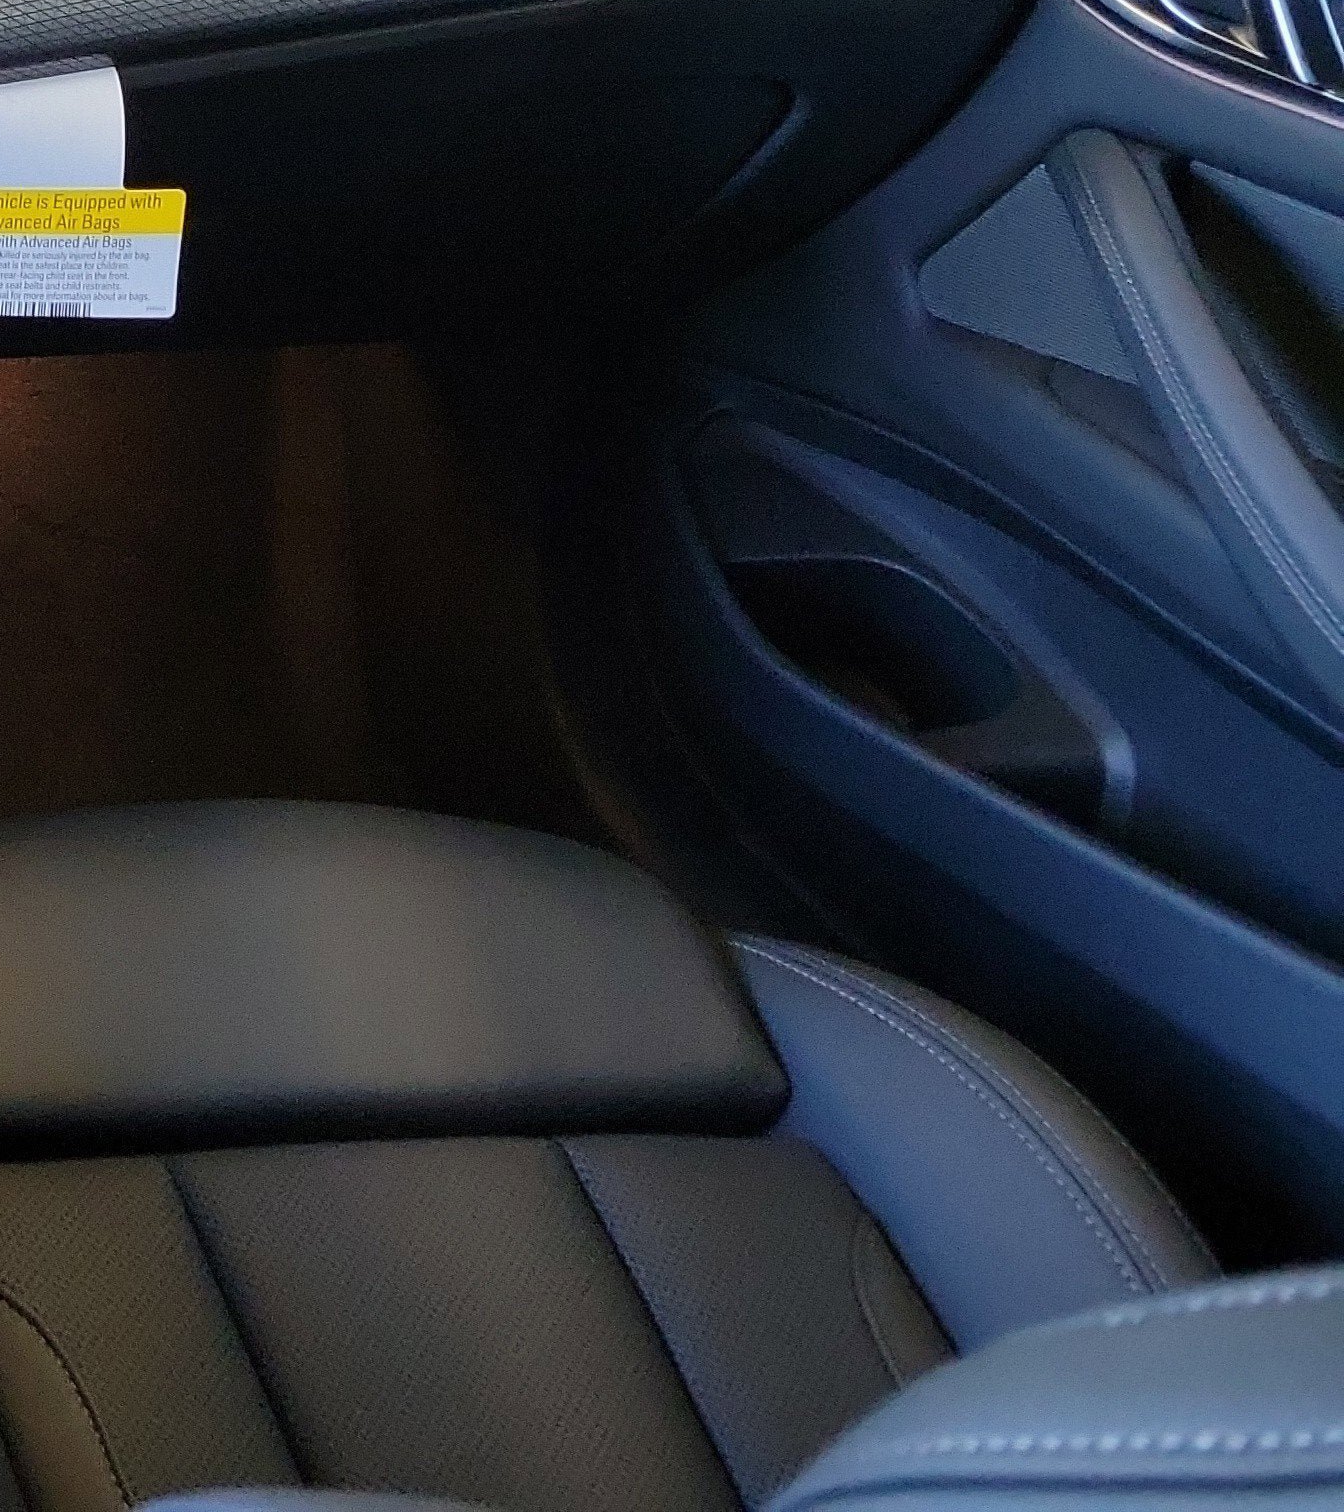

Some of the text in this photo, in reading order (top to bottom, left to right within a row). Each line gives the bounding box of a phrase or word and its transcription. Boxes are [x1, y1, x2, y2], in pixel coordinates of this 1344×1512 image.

[36, 193, 49, 209] is
[53, 193, 127, 212] Equipped
[130, 192, 162, 209] with
[56, 213, 78, 229] Air
[81, 213, 120, 233] Bags
[19, 235, 80, 249] Advanced
[82, 235, 98, 249] Air
[102, 235, 132, 250] Bags
[0, 250, 21, 259] killed
[32, 251, 67, 261] seriously
[69, 251, 96, 261] injured
[98, 251, 107, 262] by
[109, 251, 122, 260] the
[12, 261, 19, 269] is
[20, 260, 34, 269] the
[35, 261, 59, 270] safest
[60, 261, 83, 271] place
[84, 261, 95, 270] for
[46, 271, 65, 280] child
[67, 272, 84, 280] seat
[85, 272, 93, 280] in
[95, 271, 107, 280] the
[5, 280, 22, 290] seat
[23, 281, 44, 290] belts
[45, 282, 60, 290] and
[61, 281, 81, 290] child
[11, 290, 22, 300] for
[23, 292, 44, 300] more
[46, 291, 92, 301] information
[92, 291, 116, 301] about
